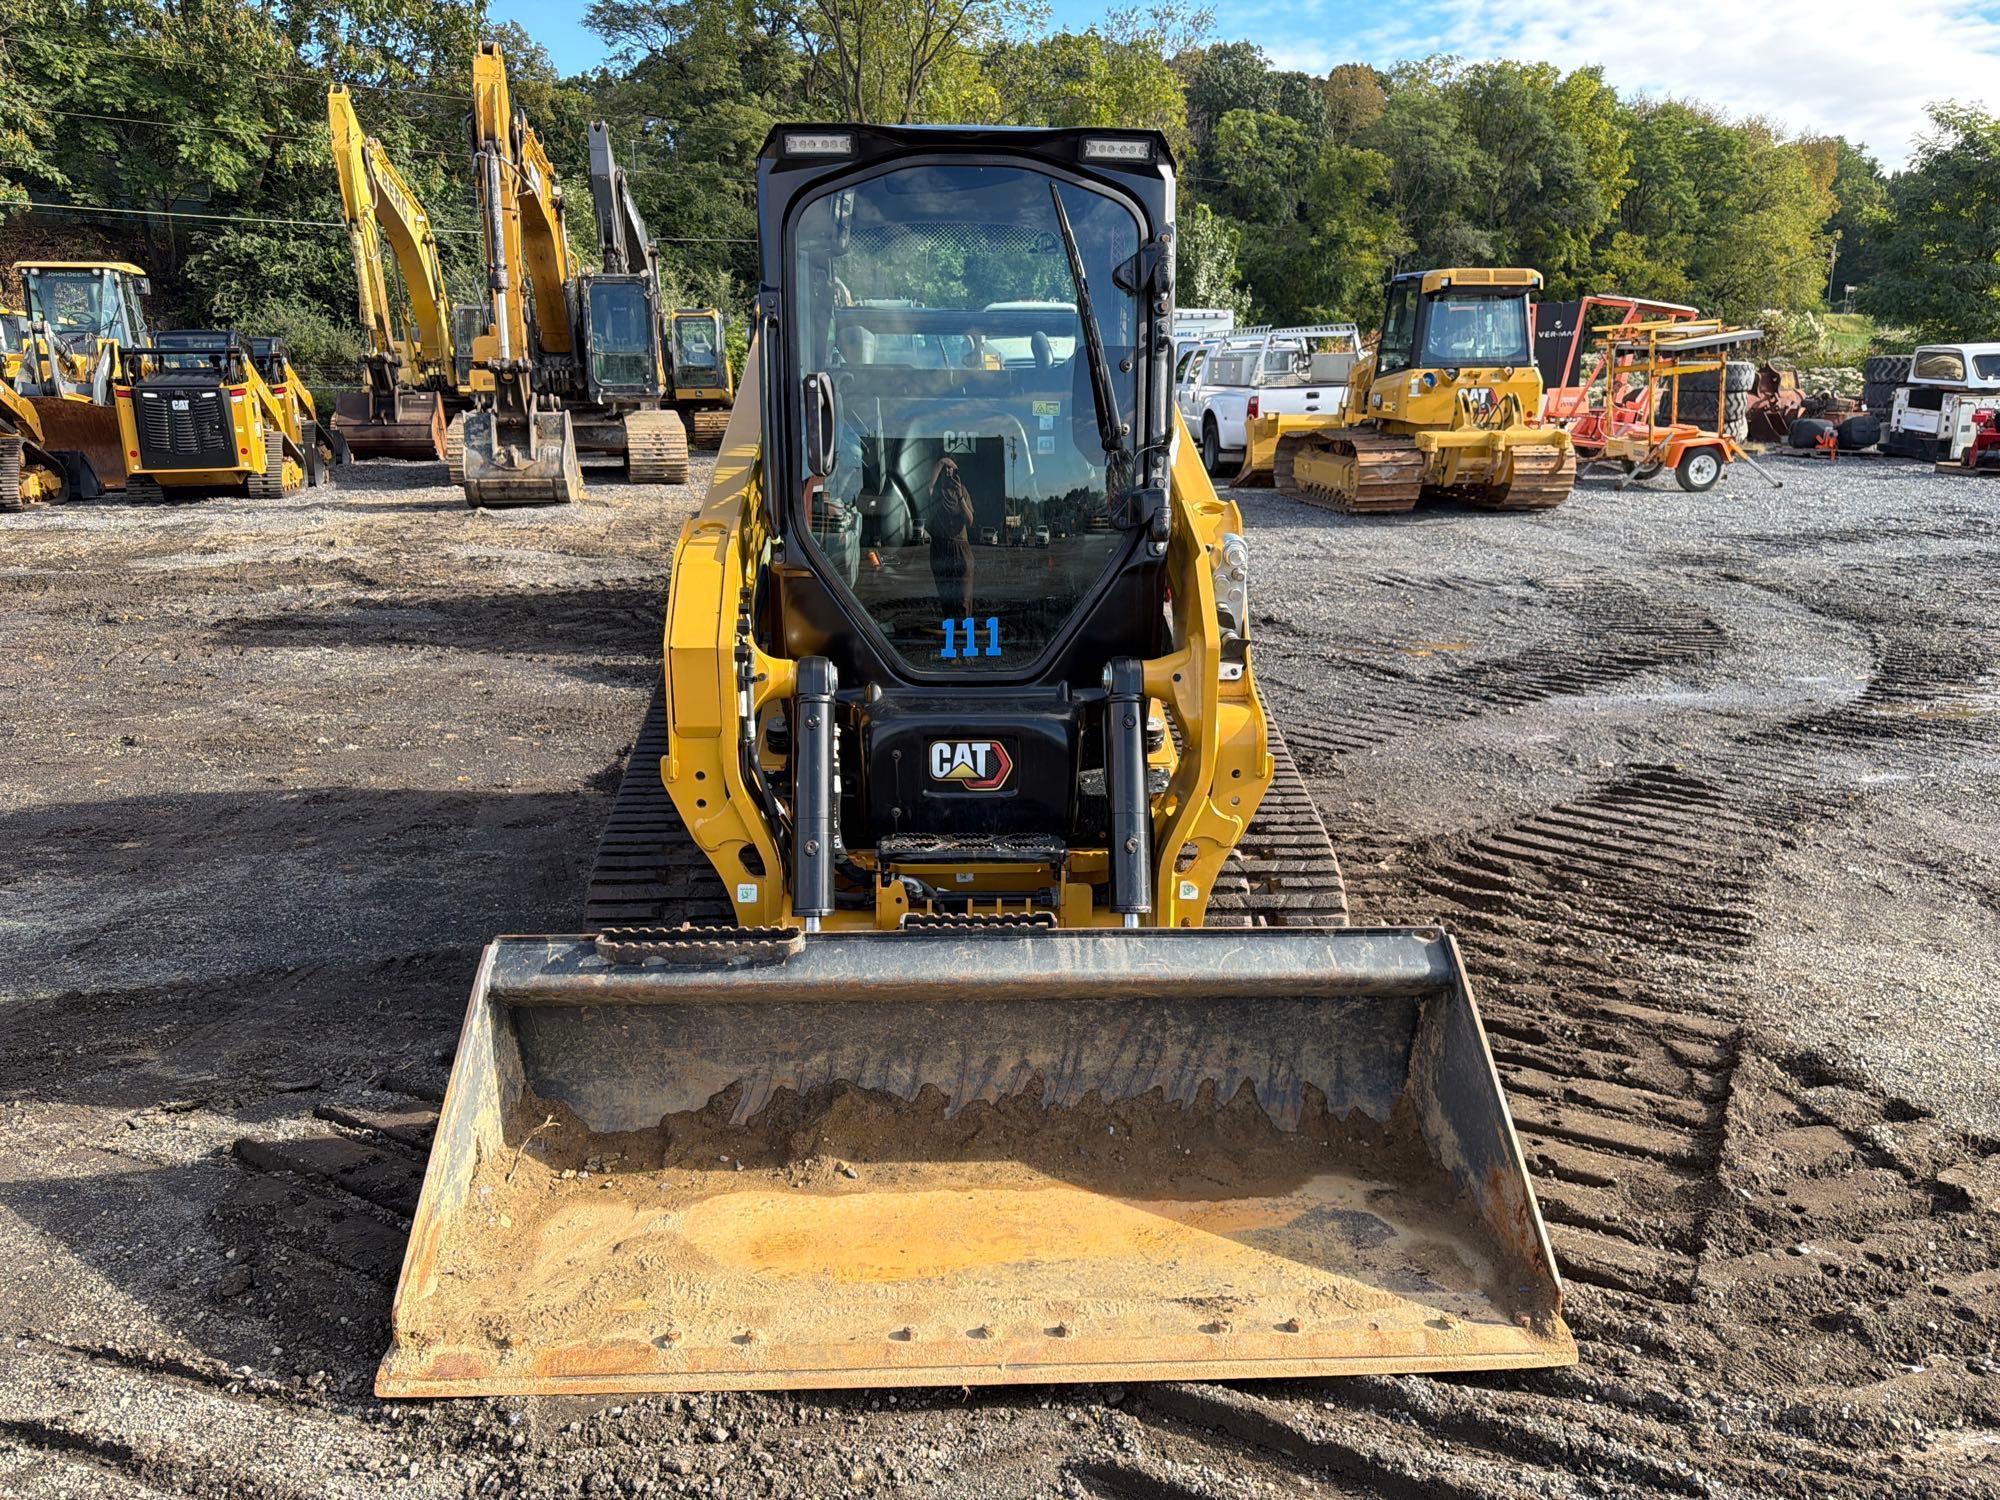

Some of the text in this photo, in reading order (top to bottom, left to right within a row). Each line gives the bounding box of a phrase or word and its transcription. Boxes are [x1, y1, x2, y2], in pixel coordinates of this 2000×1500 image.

[171, 400, 190, 410] CAT
[943, 430, 979, 454] CAT
[940, 616, 1002, 658] 111
[931, 742, 991, 778] CAT
